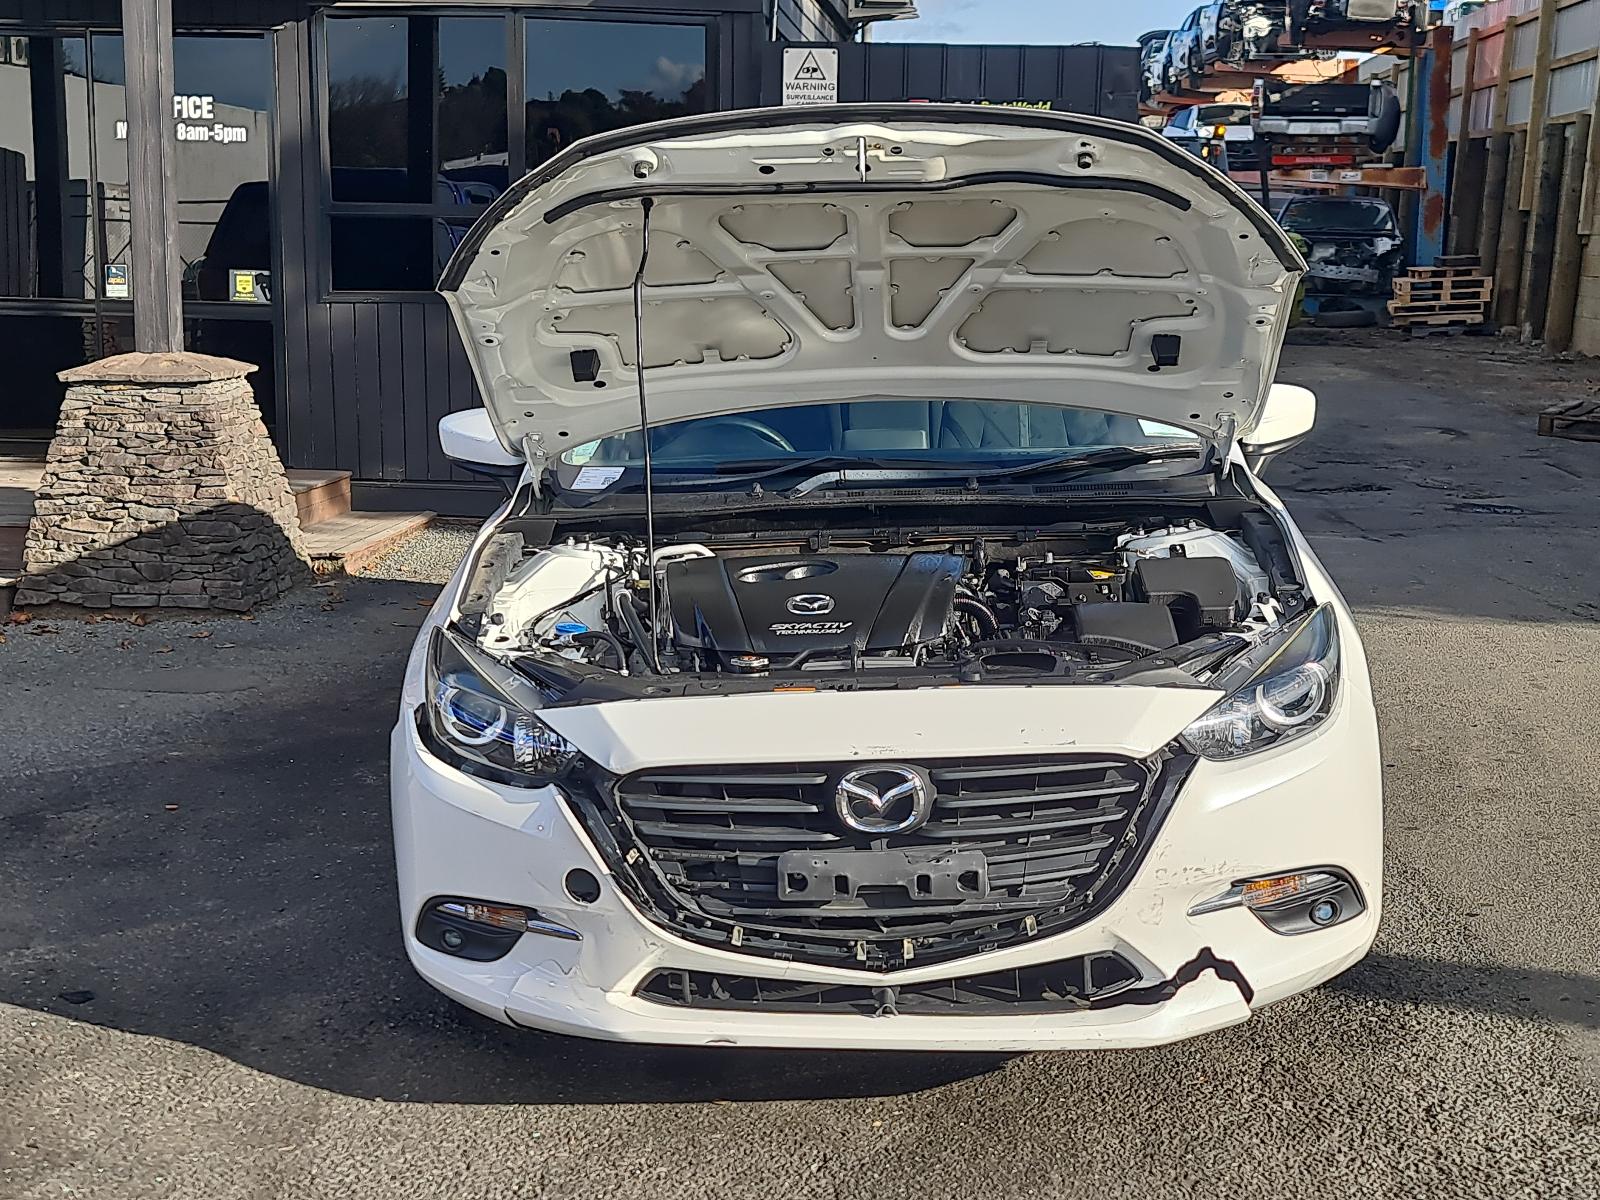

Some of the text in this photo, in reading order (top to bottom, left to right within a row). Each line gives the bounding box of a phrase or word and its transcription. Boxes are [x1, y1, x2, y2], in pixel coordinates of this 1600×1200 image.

[785, 82, 836, 91] WARNING
[173, 95, 214, 119] FICE
[176, 122, 247, 143] 8am-5pm
[768, 621, 853, 630] SKYACTIV
